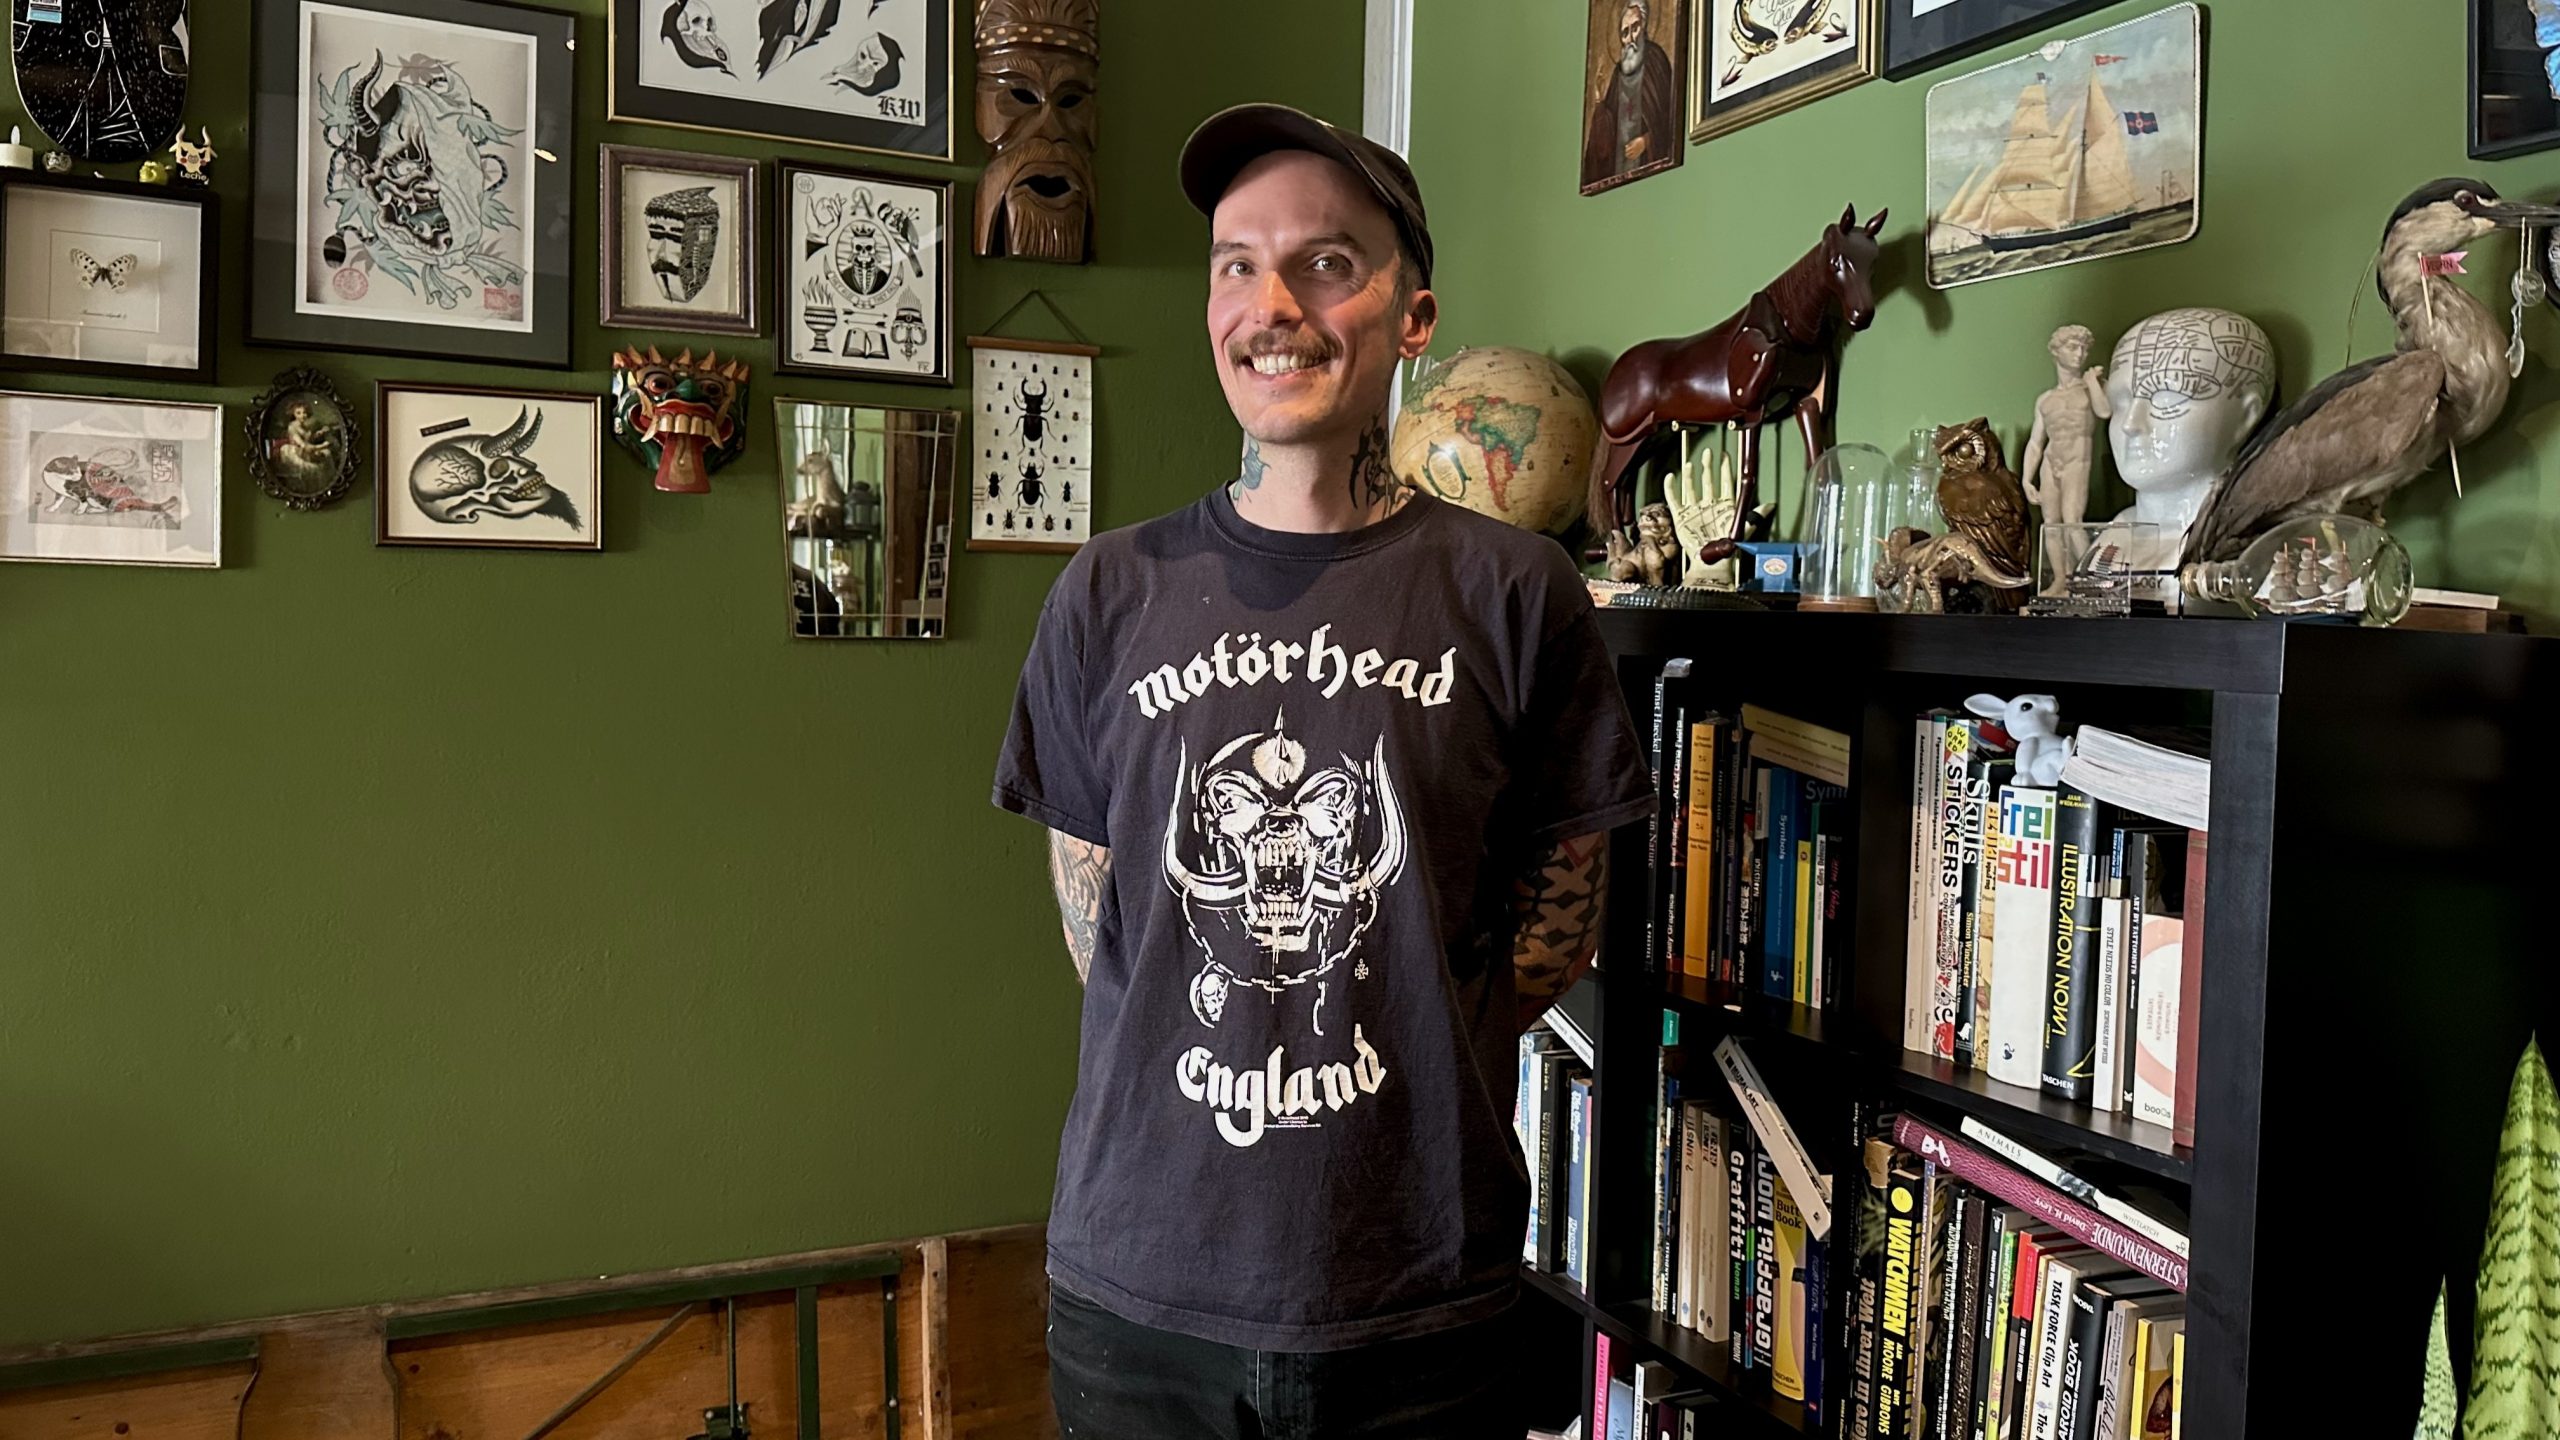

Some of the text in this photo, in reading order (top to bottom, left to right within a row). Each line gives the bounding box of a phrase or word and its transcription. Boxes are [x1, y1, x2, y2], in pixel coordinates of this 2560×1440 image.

[1653, 683, 1663, 753] Ernst Haeckel
[1805, 780, 1849, 802] Sym
[1779, 815, 1787, 860] Symbols
[1942, 764, 1963, 888] STICKERS
[1964, 778, 1990, 864] Skulls
[1648, 833, 1657, 869] Nature
[2051, 844, 2079, 1036] ILLUSTRATION NOW!
[2132, 912, 2139, 923] BY
[1962, 912, 1974, 988] Simon Winchester
[2103, 926, 2114, 1006] STYLE NEEDS NO COLOR
[2130, 925, 2139, 975] TATTOOISTS
[1174, 1022, 1386, 1149] England
[1732, 1065, 1760, 1108] MURAL ART
[2042, 1073, 2075, 1090] TASCHEN
[1977, 1128, 2022, 1158] ANIMALS
[1730, 1150, 1746, 1300] Graffiti Woman
[1775, 1212, 1802, 1229] Book
[1777, 1199, 1799, 1217] Butt
[2063, 1212, 2087, 1232] David
[2123, 1212, 2160, 1238] WHITLATCH
[2091, 1222, 2182, 1286] STERNENKUNDE
[1858, 1277, 1876, 1323] Welt
[1883, 1218, 1912, 1337] WATCHMEN
[1733, 1331, 1742, 1364] DUMONT
[1855, 1323, 1873, 1379] ihrer
[2041, 1279, 2063, 1388] TASK FORCE Clip Art
[1882, 1338, 1895, 1381] MOORE
[2063, 1338, 2080, 1389] BOOK
[1854, 1380, 1869, 1404] in
[1878, 1385, 1892, 1435] GIBBONS
[2036, 1413, 2048, 1433] The
